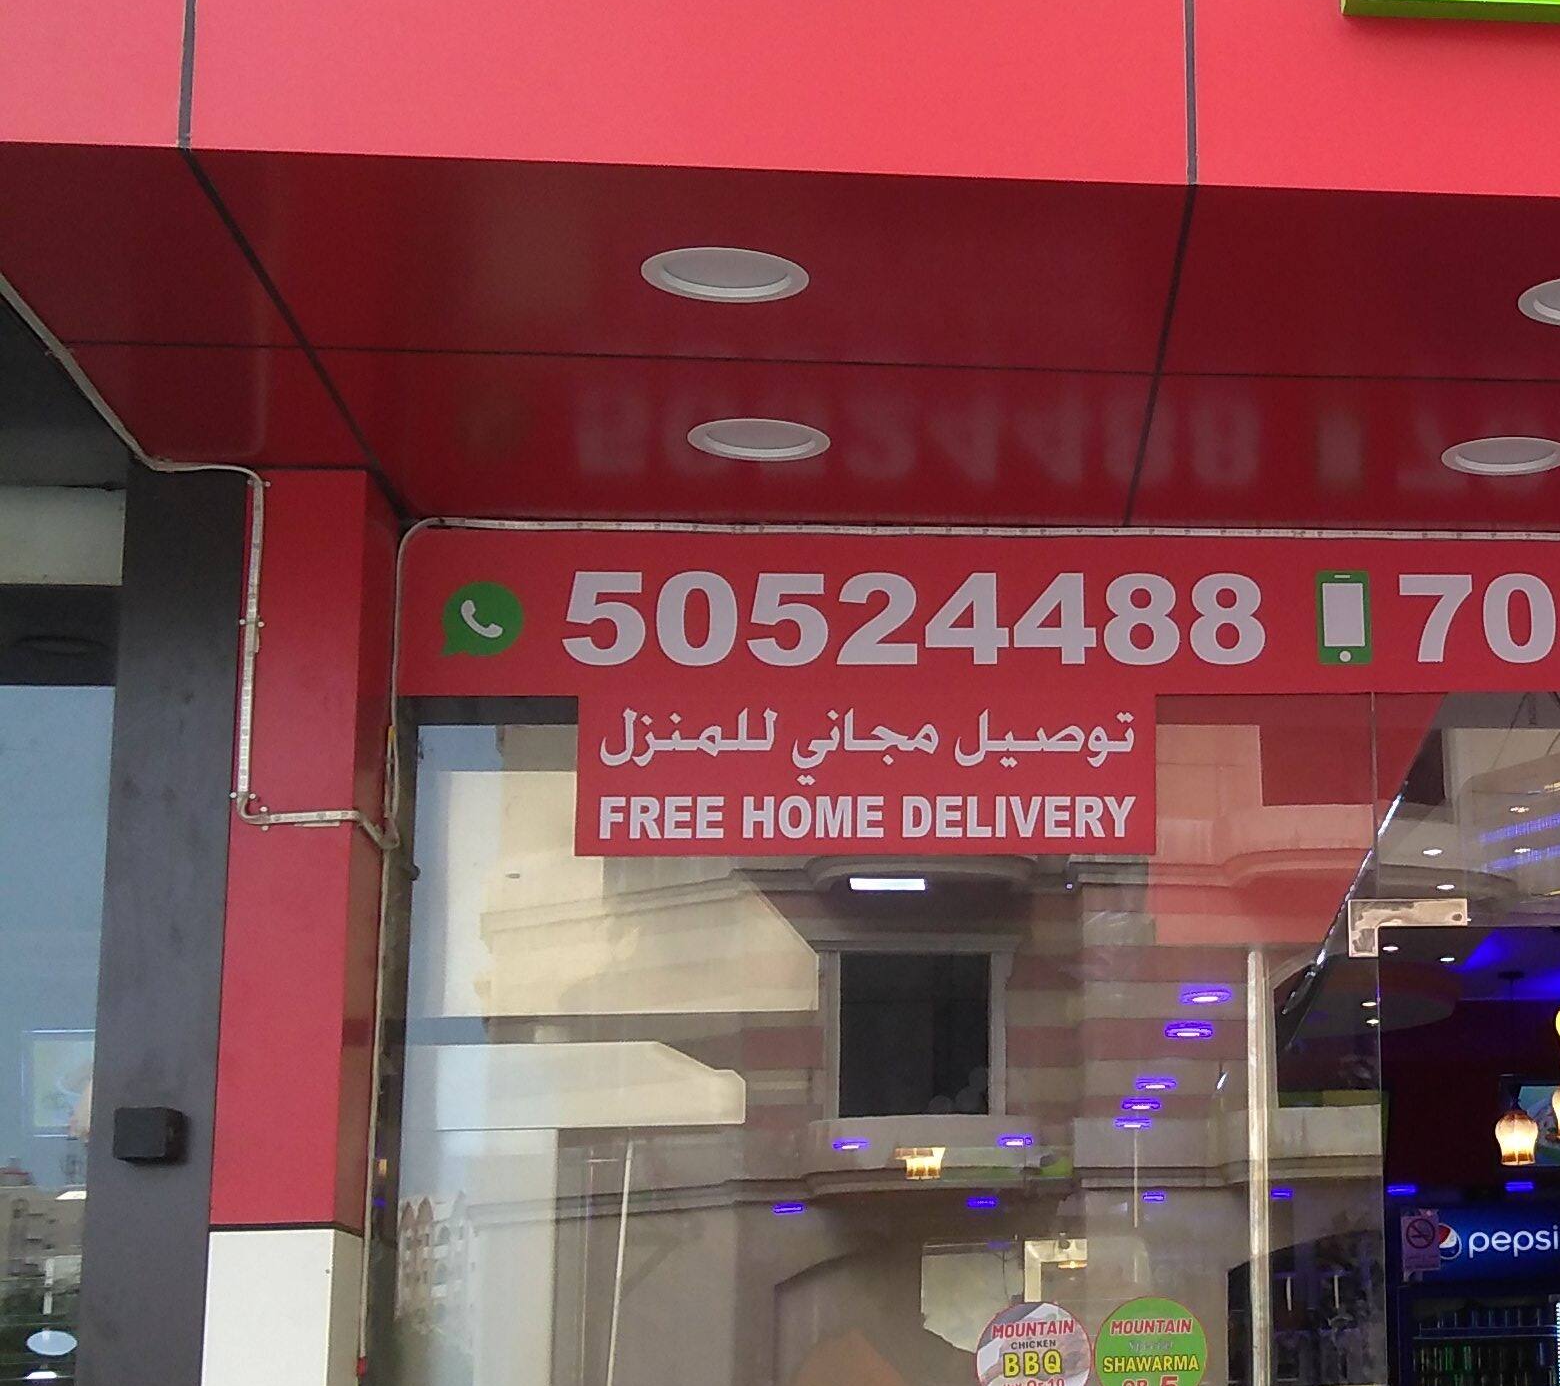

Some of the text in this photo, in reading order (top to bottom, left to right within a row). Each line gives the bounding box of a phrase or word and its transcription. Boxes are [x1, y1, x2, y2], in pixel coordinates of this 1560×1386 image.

[562, 571, 1266, 666] 50524488
[600, 708, 1136, 785] توصيل مجاني للمنزل
[600, 796, 1136, 841] FREE HOME DELIVERY
[1469, 1225, 1560, 1258] pepsi
[992, 1319, 1075, 1338] MOUNTAIN
[1111, 1319, 1192, 1335] MOUNTAIN
[1010, 1339, 1056, 1350] CHICKEN
[1102, 1355, 1199, 1373] SHAWARMA
